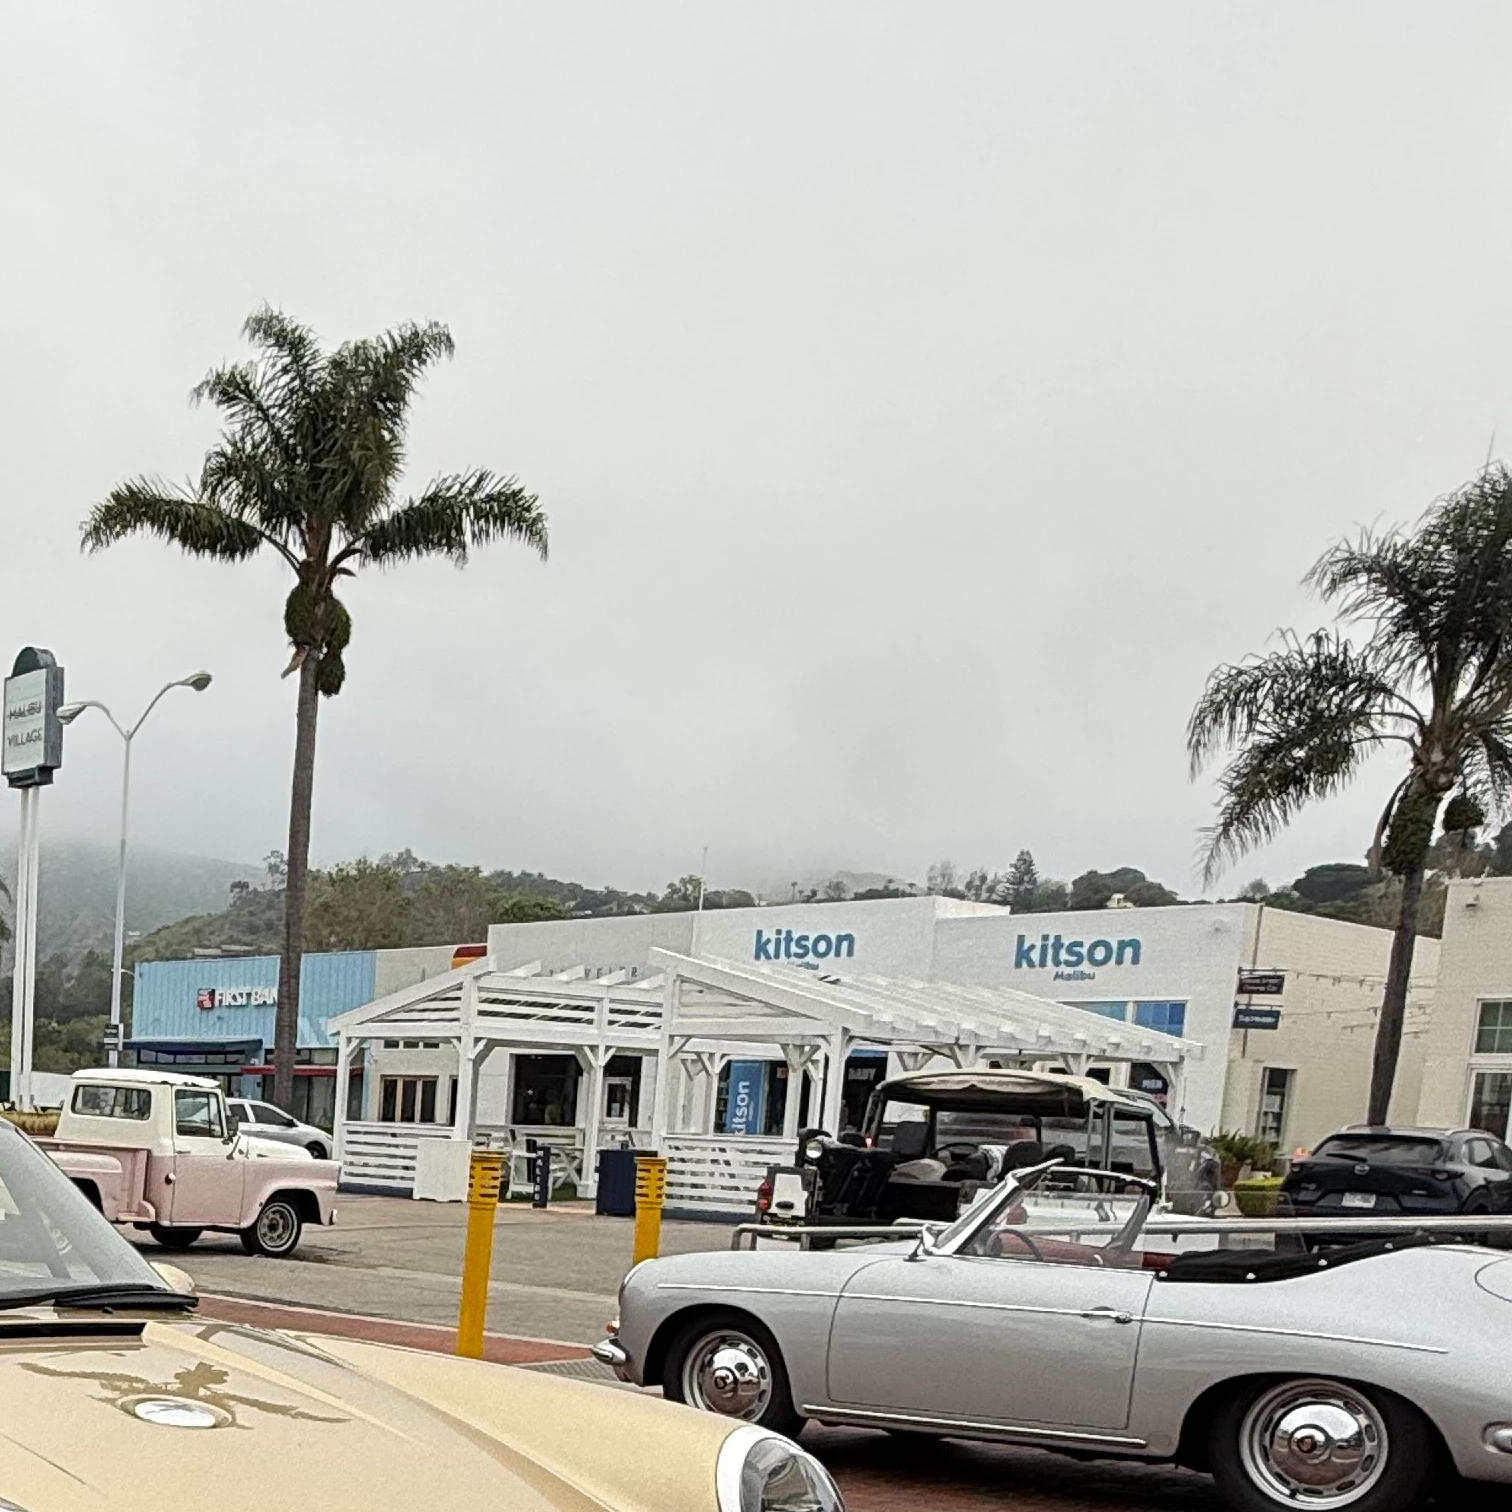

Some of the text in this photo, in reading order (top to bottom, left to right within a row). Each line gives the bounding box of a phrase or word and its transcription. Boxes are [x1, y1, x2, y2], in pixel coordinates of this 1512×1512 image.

[7, 727, 43, 747] VILLAGE
[754, 929, 855, 960] kitson
[1014, 934, 1142, 969] kitson
[1053, 971, 1096, 981] Malibu
[215, 988, 278, 1006] FIRST BAN
